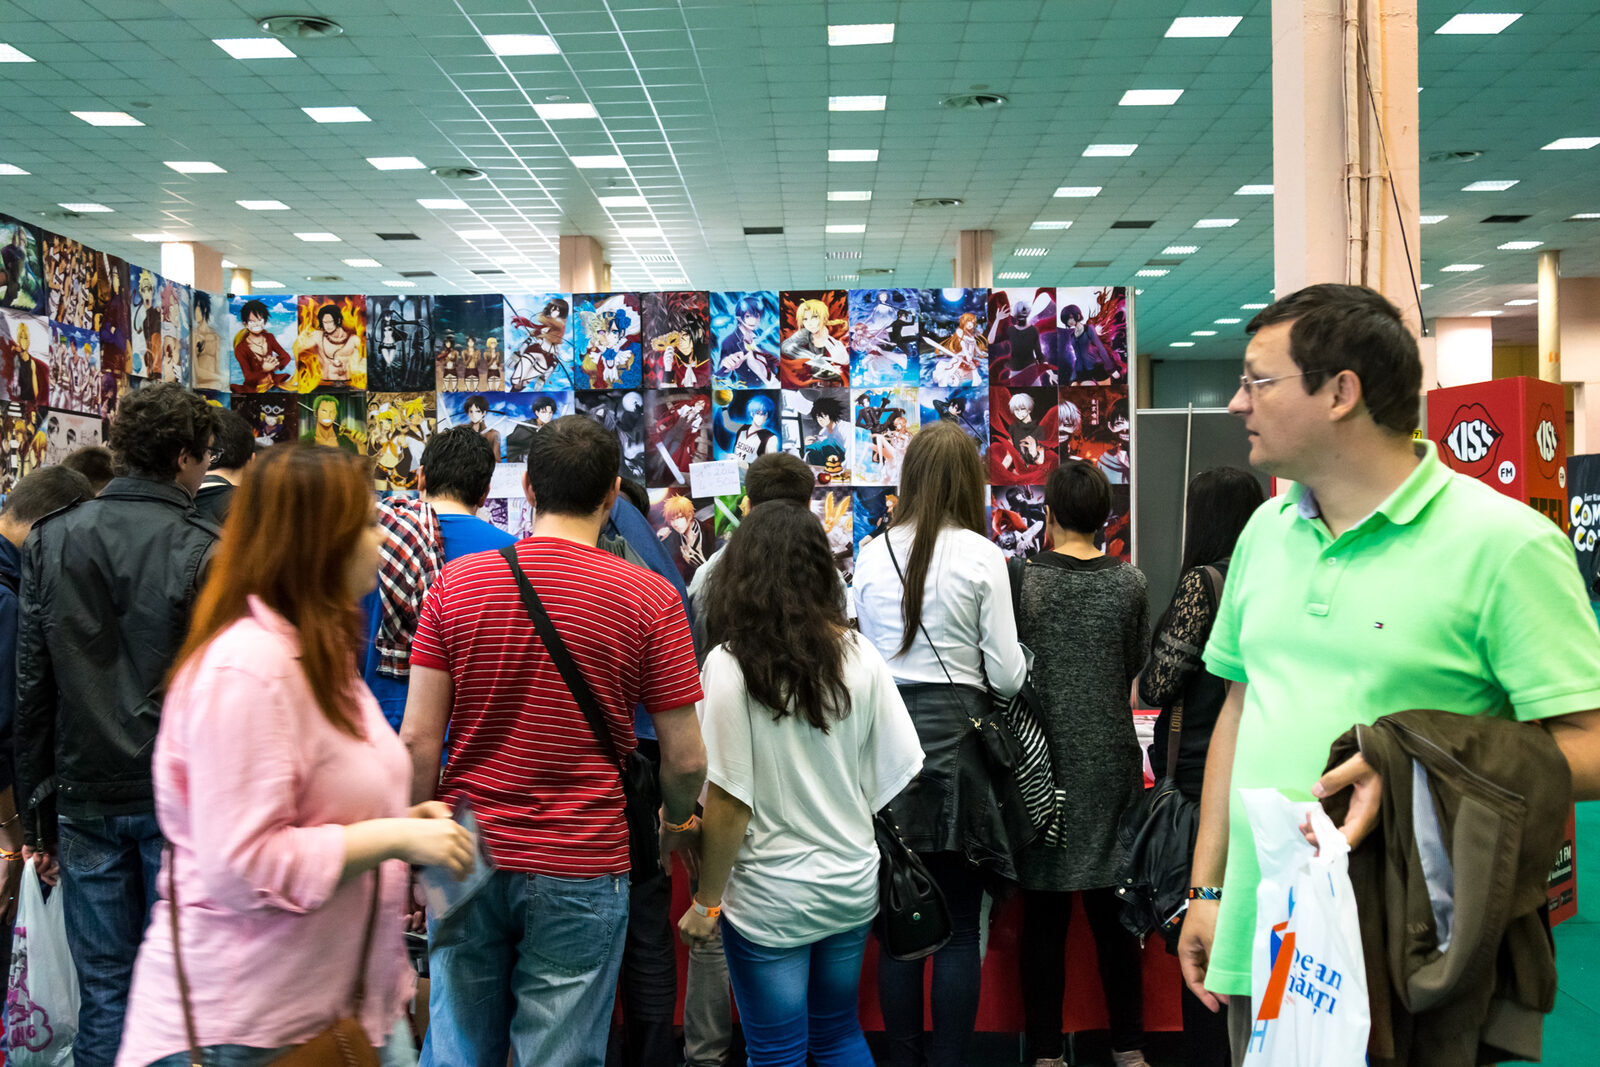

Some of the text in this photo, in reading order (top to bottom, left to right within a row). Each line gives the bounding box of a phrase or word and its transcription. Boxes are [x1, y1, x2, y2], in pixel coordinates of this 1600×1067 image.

[1447, 419, 1494, 462] KISS
[1536, 420, 1557, 461] KISS
[1500, 468, 1513, 477] FM
[1574, 526, 1600, 551] CO
